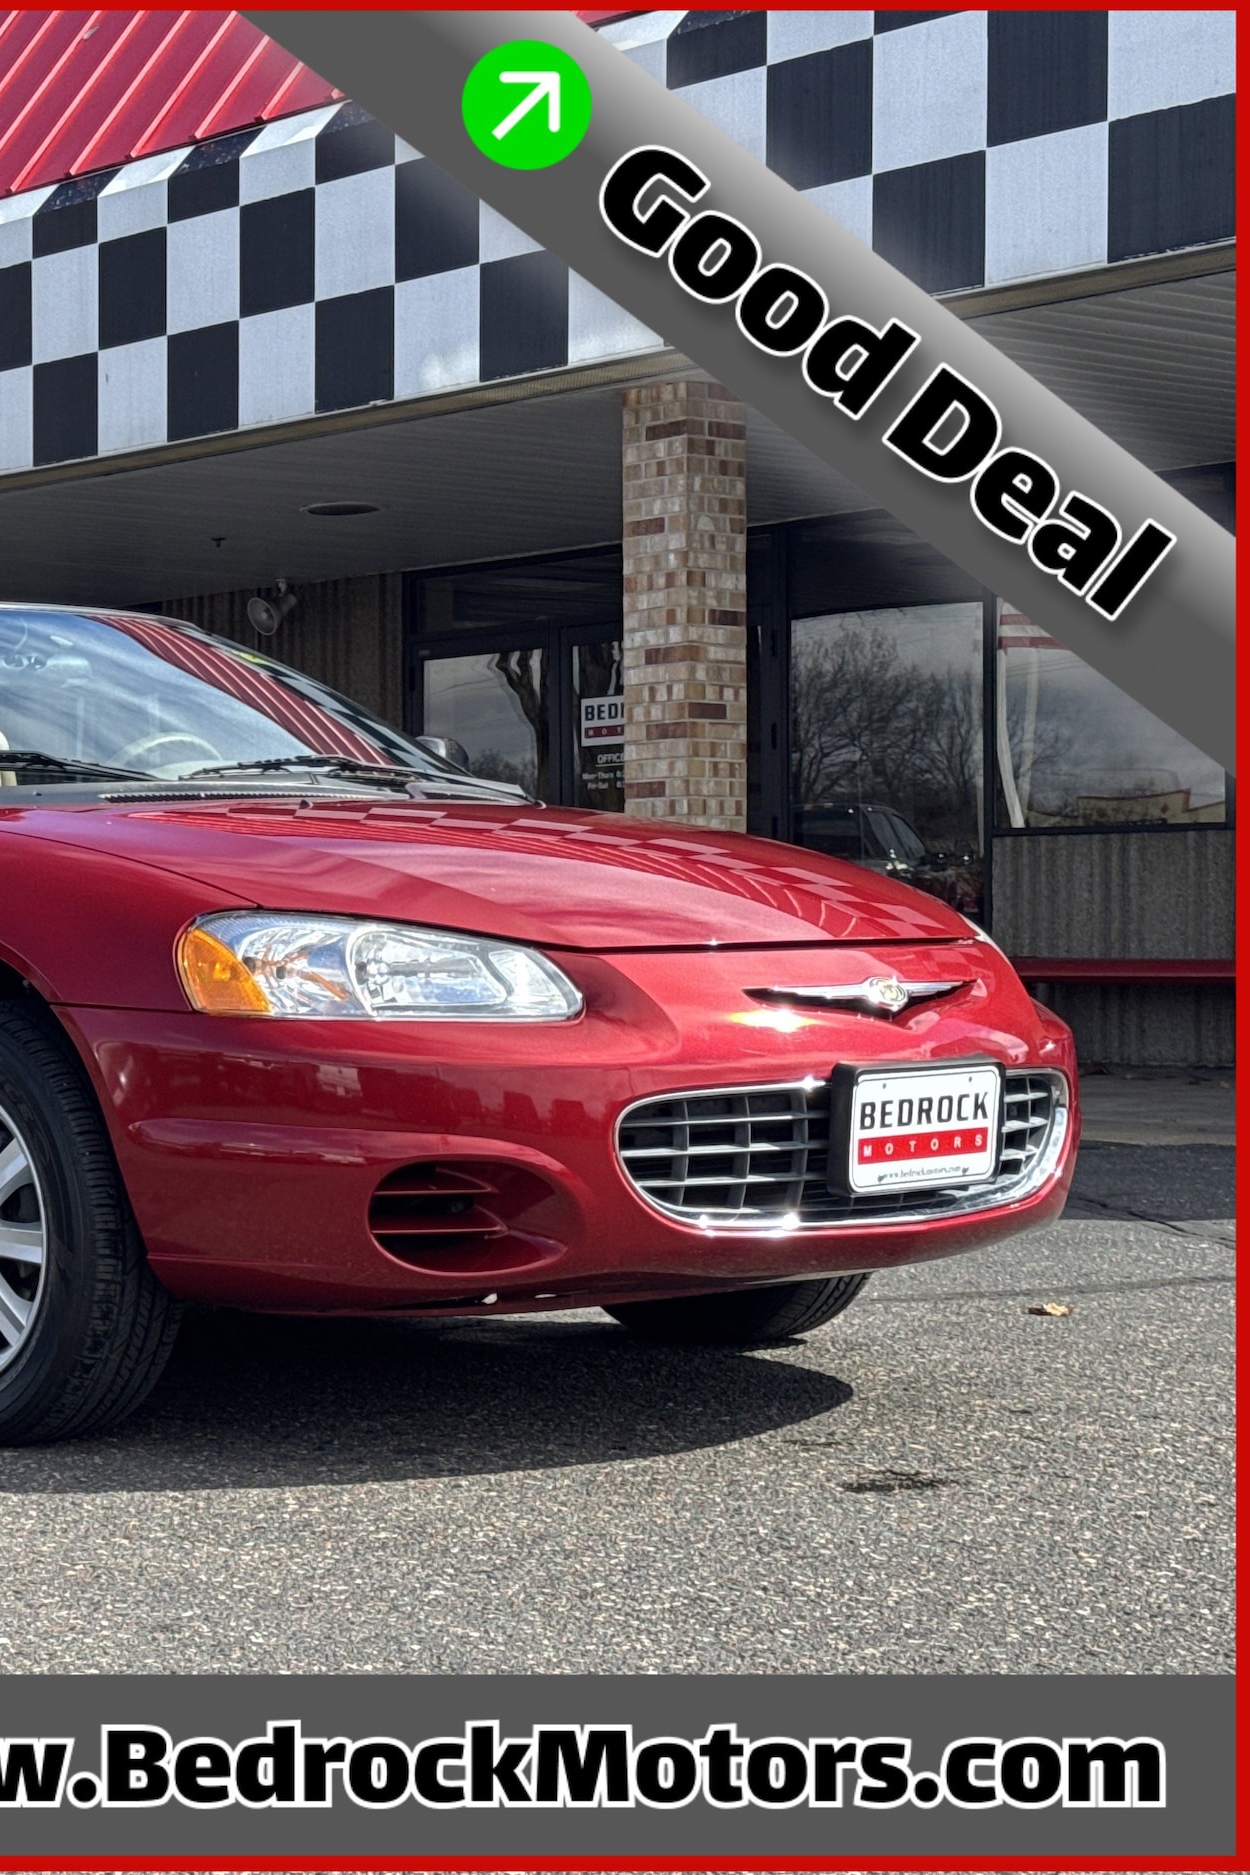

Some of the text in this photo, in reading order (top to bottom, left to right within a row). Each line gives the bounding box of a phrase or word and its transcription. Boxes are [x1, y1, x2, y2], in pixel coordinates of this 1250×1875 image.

[584, 702, 624, 721] BED
[859, 1091, 989, 1131] BEDROCK
[863, 1133, 983, 1158] MOTORS
